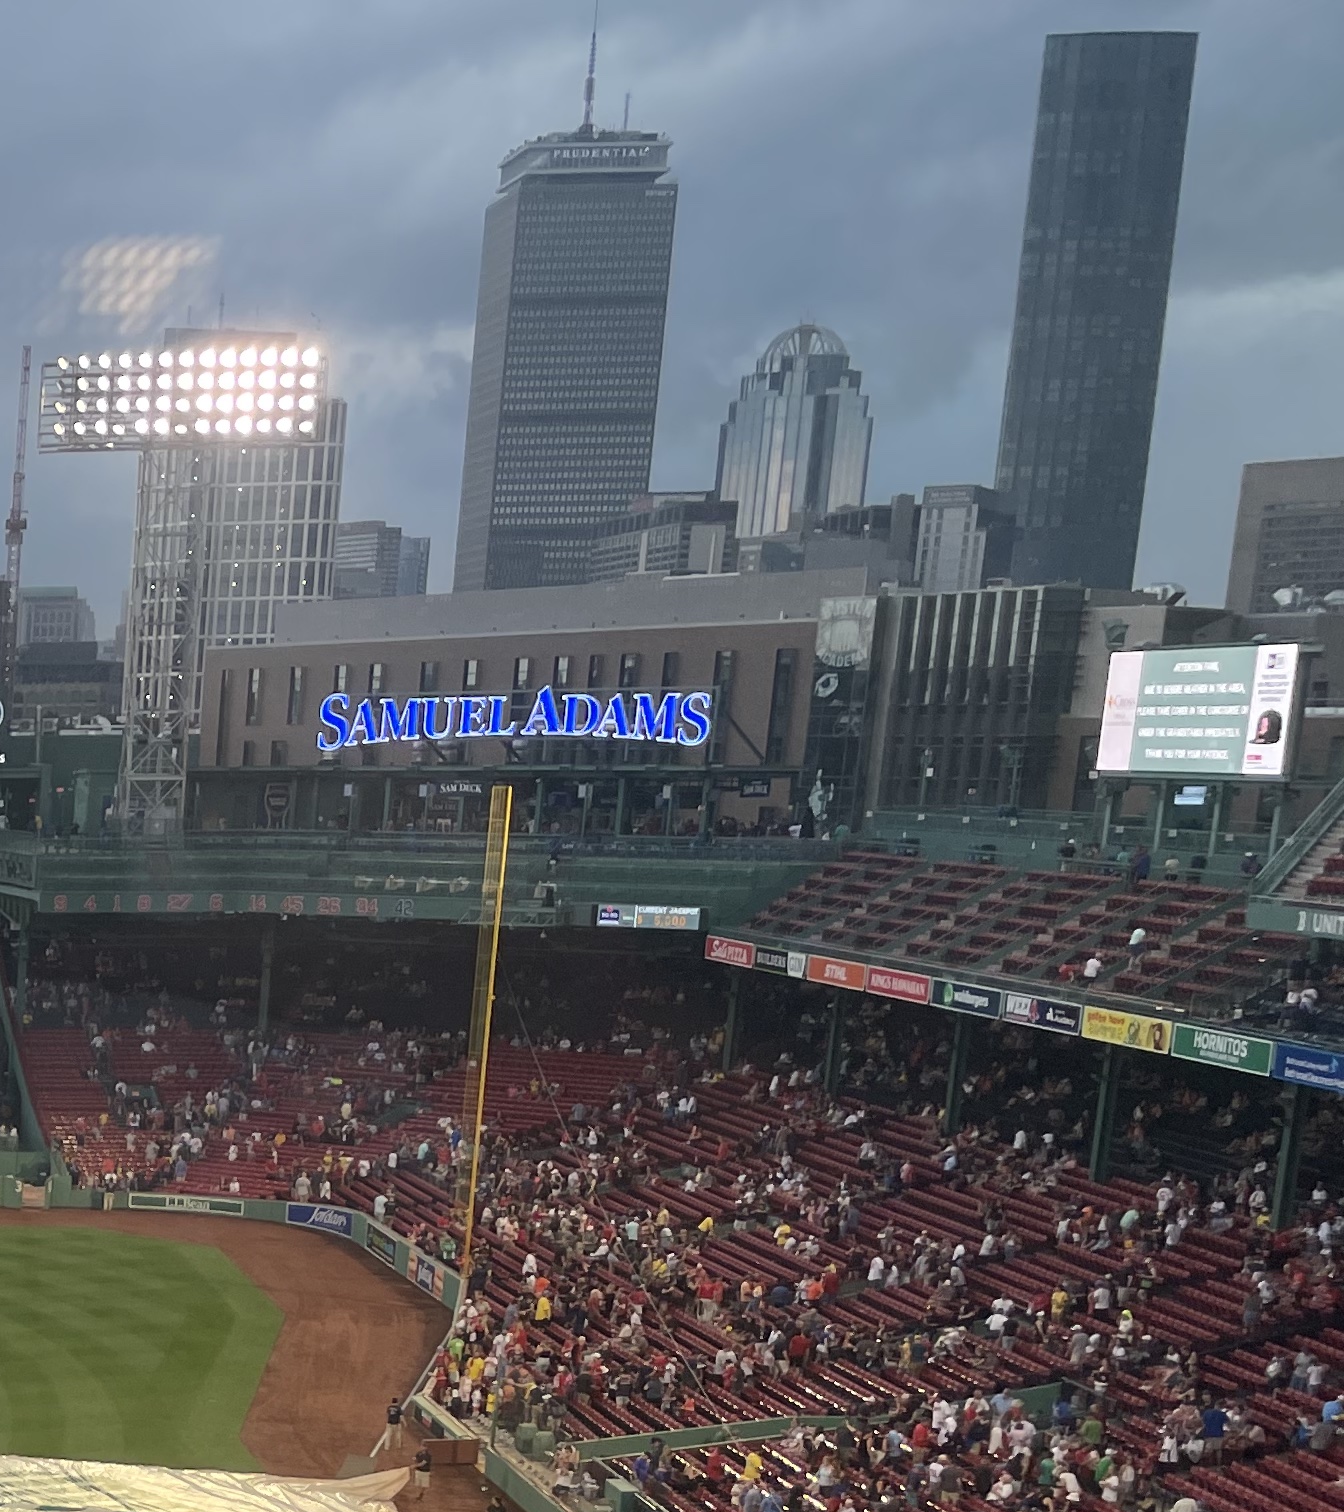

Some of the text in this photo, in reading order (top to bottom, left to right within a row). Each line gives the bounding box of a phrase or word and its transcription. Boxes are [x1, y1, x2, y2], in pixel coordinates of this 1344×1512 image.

[317, 685, 712, 752] SAMUEL ADAMS
[439, 782, 482, 794] SAM DECK
[281, 895, 304, 913] 45
[395, 898, 413, 915] 42
[1193, 1031, 1249, 1057] HORNITOS
